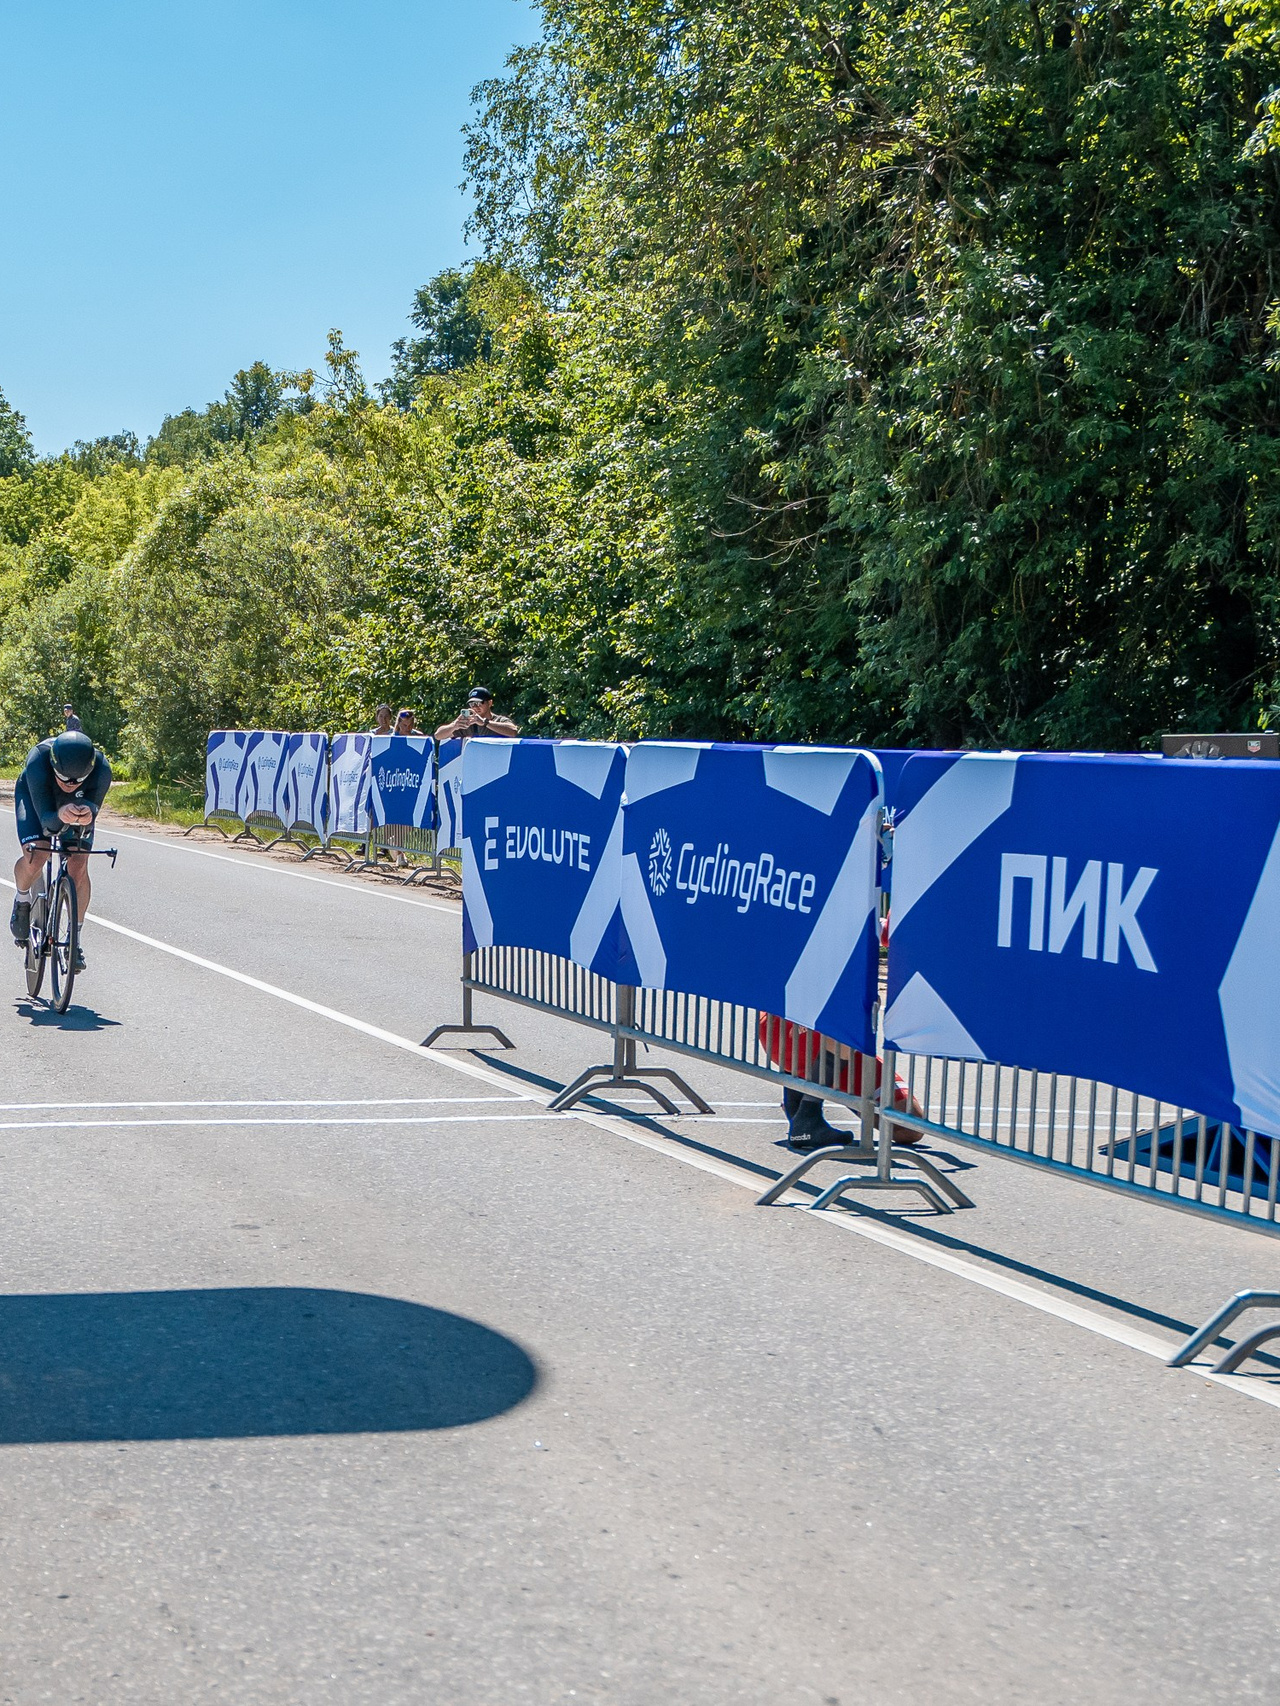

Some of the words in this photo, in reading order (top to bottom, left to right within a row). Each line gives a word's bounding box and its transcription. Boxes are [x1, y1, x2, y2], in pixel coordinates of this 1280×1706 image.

[385, 767, 420, 792] CyclingRace
[505, 825, 591, 872] EVOLUTE
[675, 842, 816, 914] CyclingRace
[996, 852, 1160, 974] ПИК
